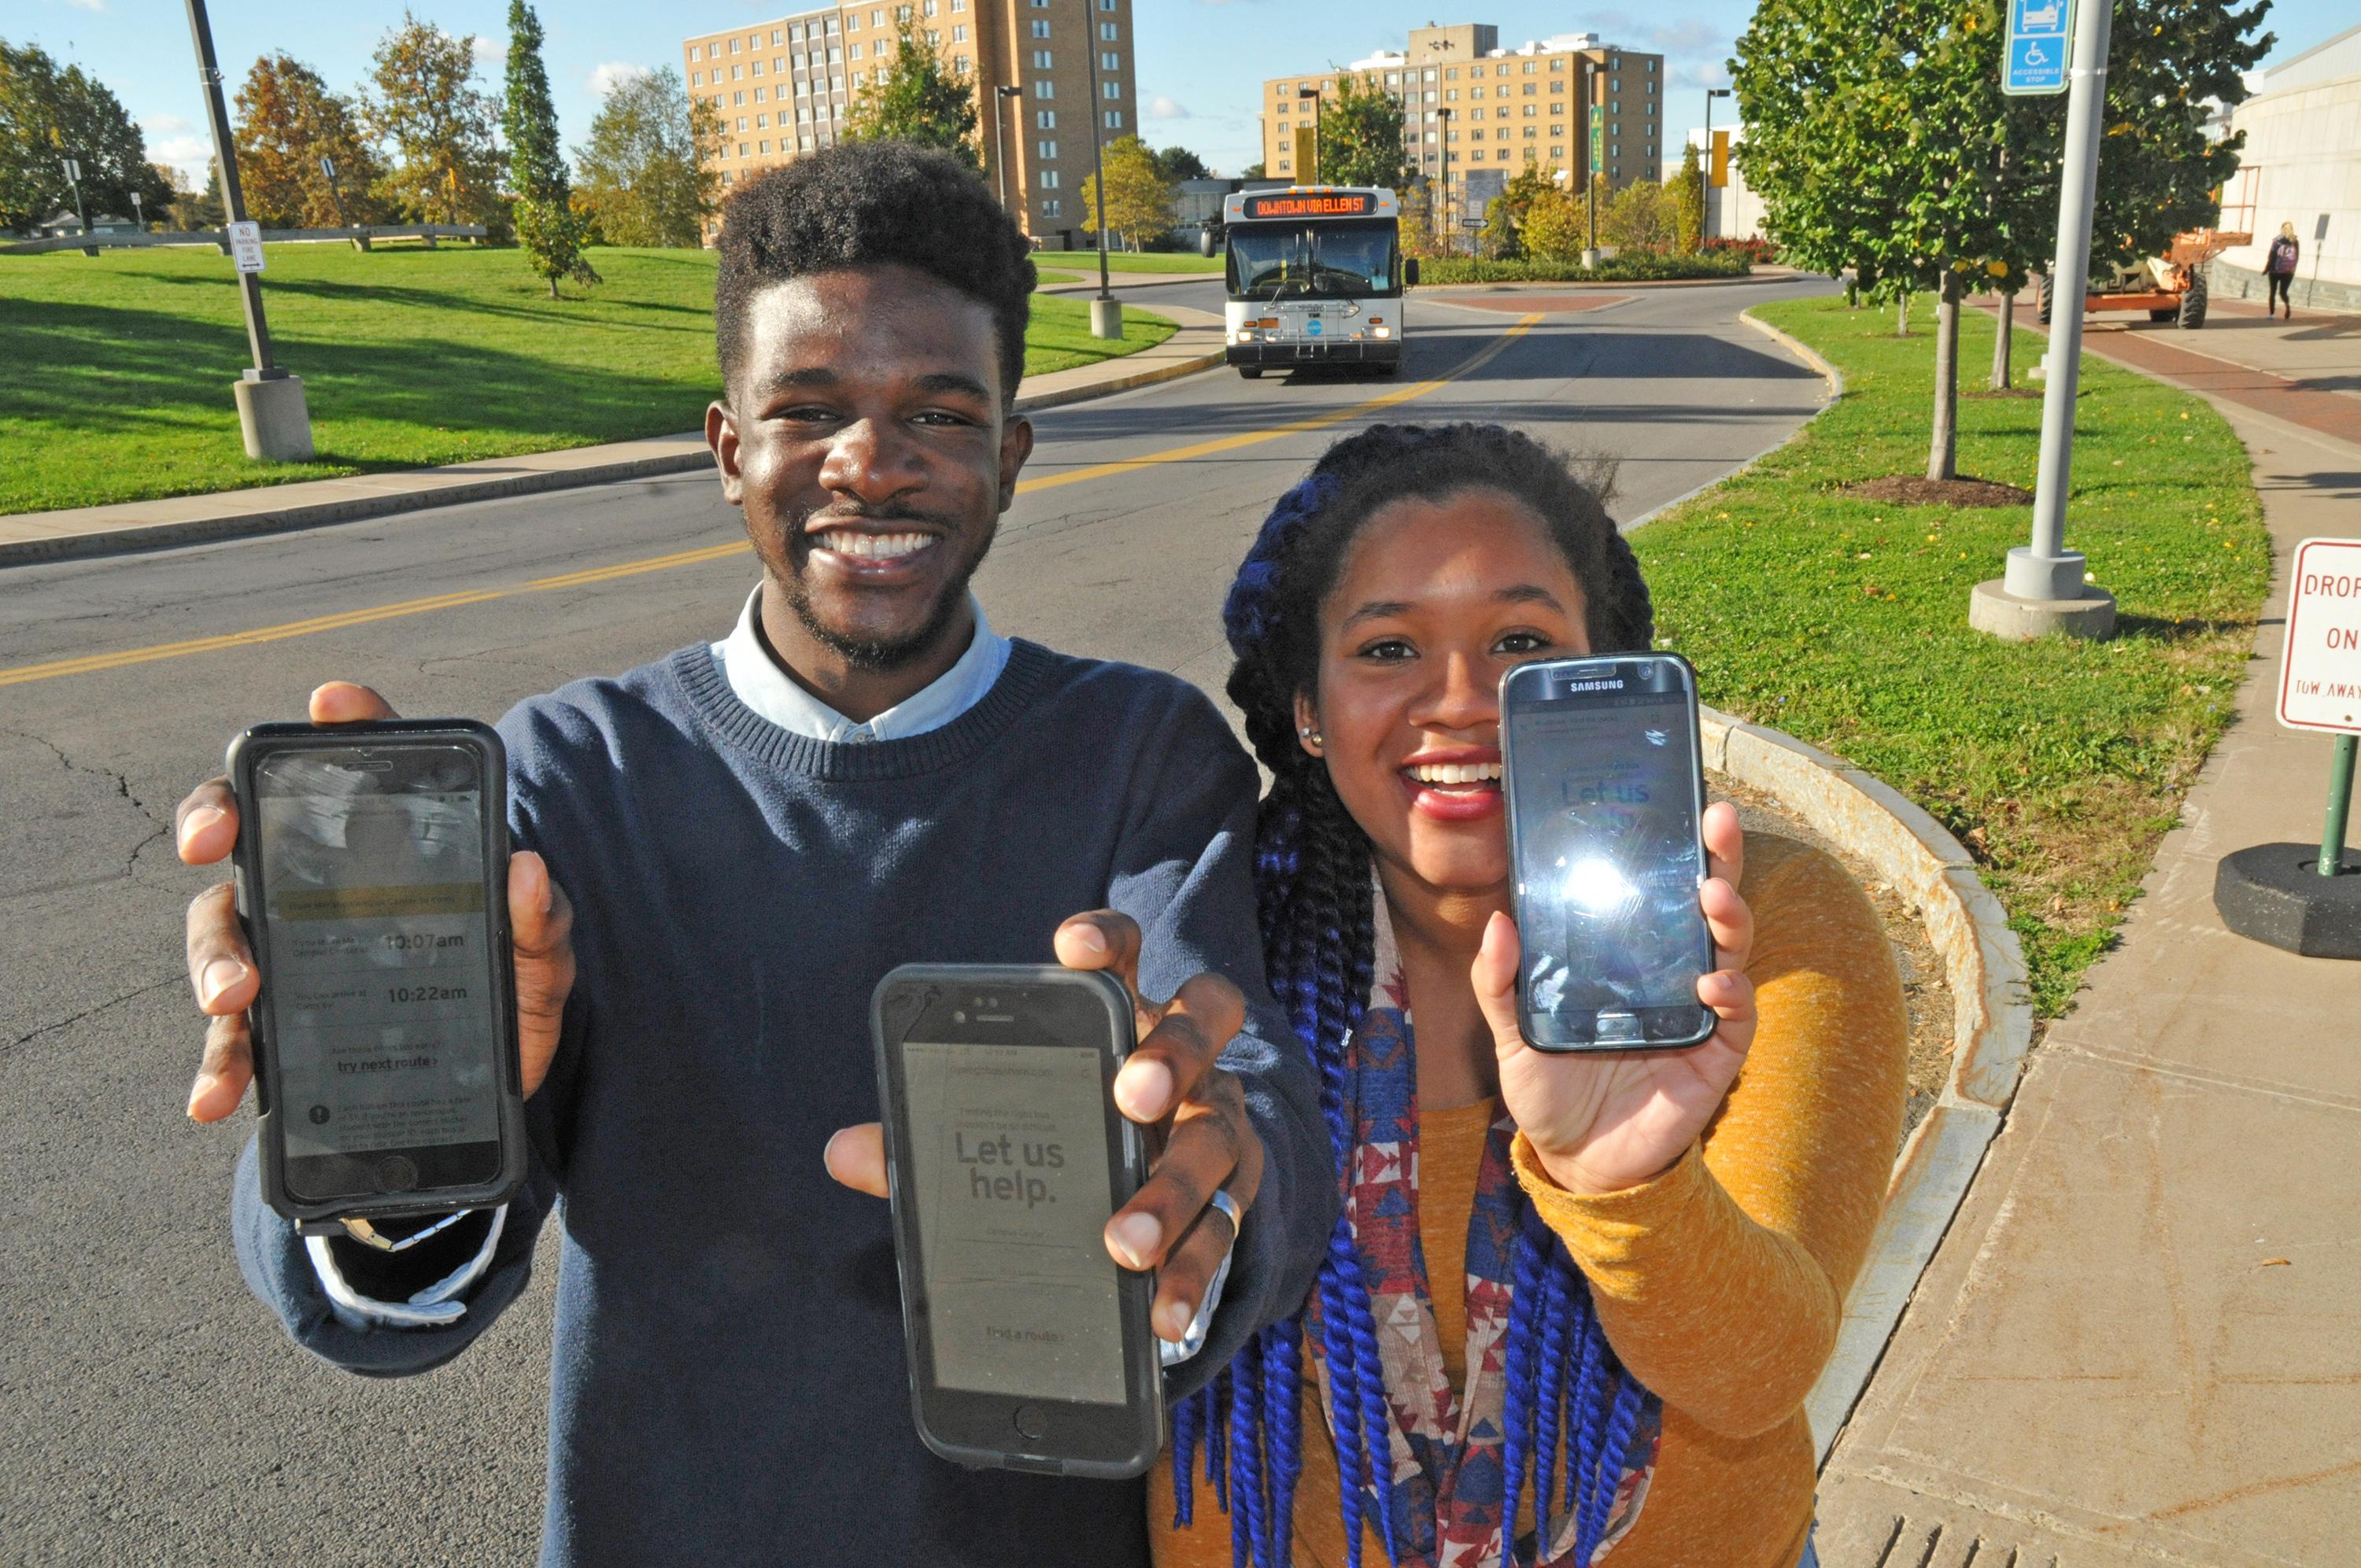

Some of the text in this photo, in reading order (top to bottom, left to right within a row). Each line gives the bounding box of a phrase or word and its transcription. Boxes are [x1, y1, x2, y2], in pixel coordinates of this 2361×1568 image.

[1257, 197, 1364, 215] DOWNTOWN VIA ELLEN ST
[239, 227, 250, 236] NO
[1570, 679, 1624, 692] SAMSUNG
[386, 934, 464, 950] 10:07am
[389, 987, 467, 1003] 10:22am
[338, 1057, 430, 1073] try next route
[955, 1131, 1064, 1168] Let us
[970, 1167, 1056, 1209] help.
